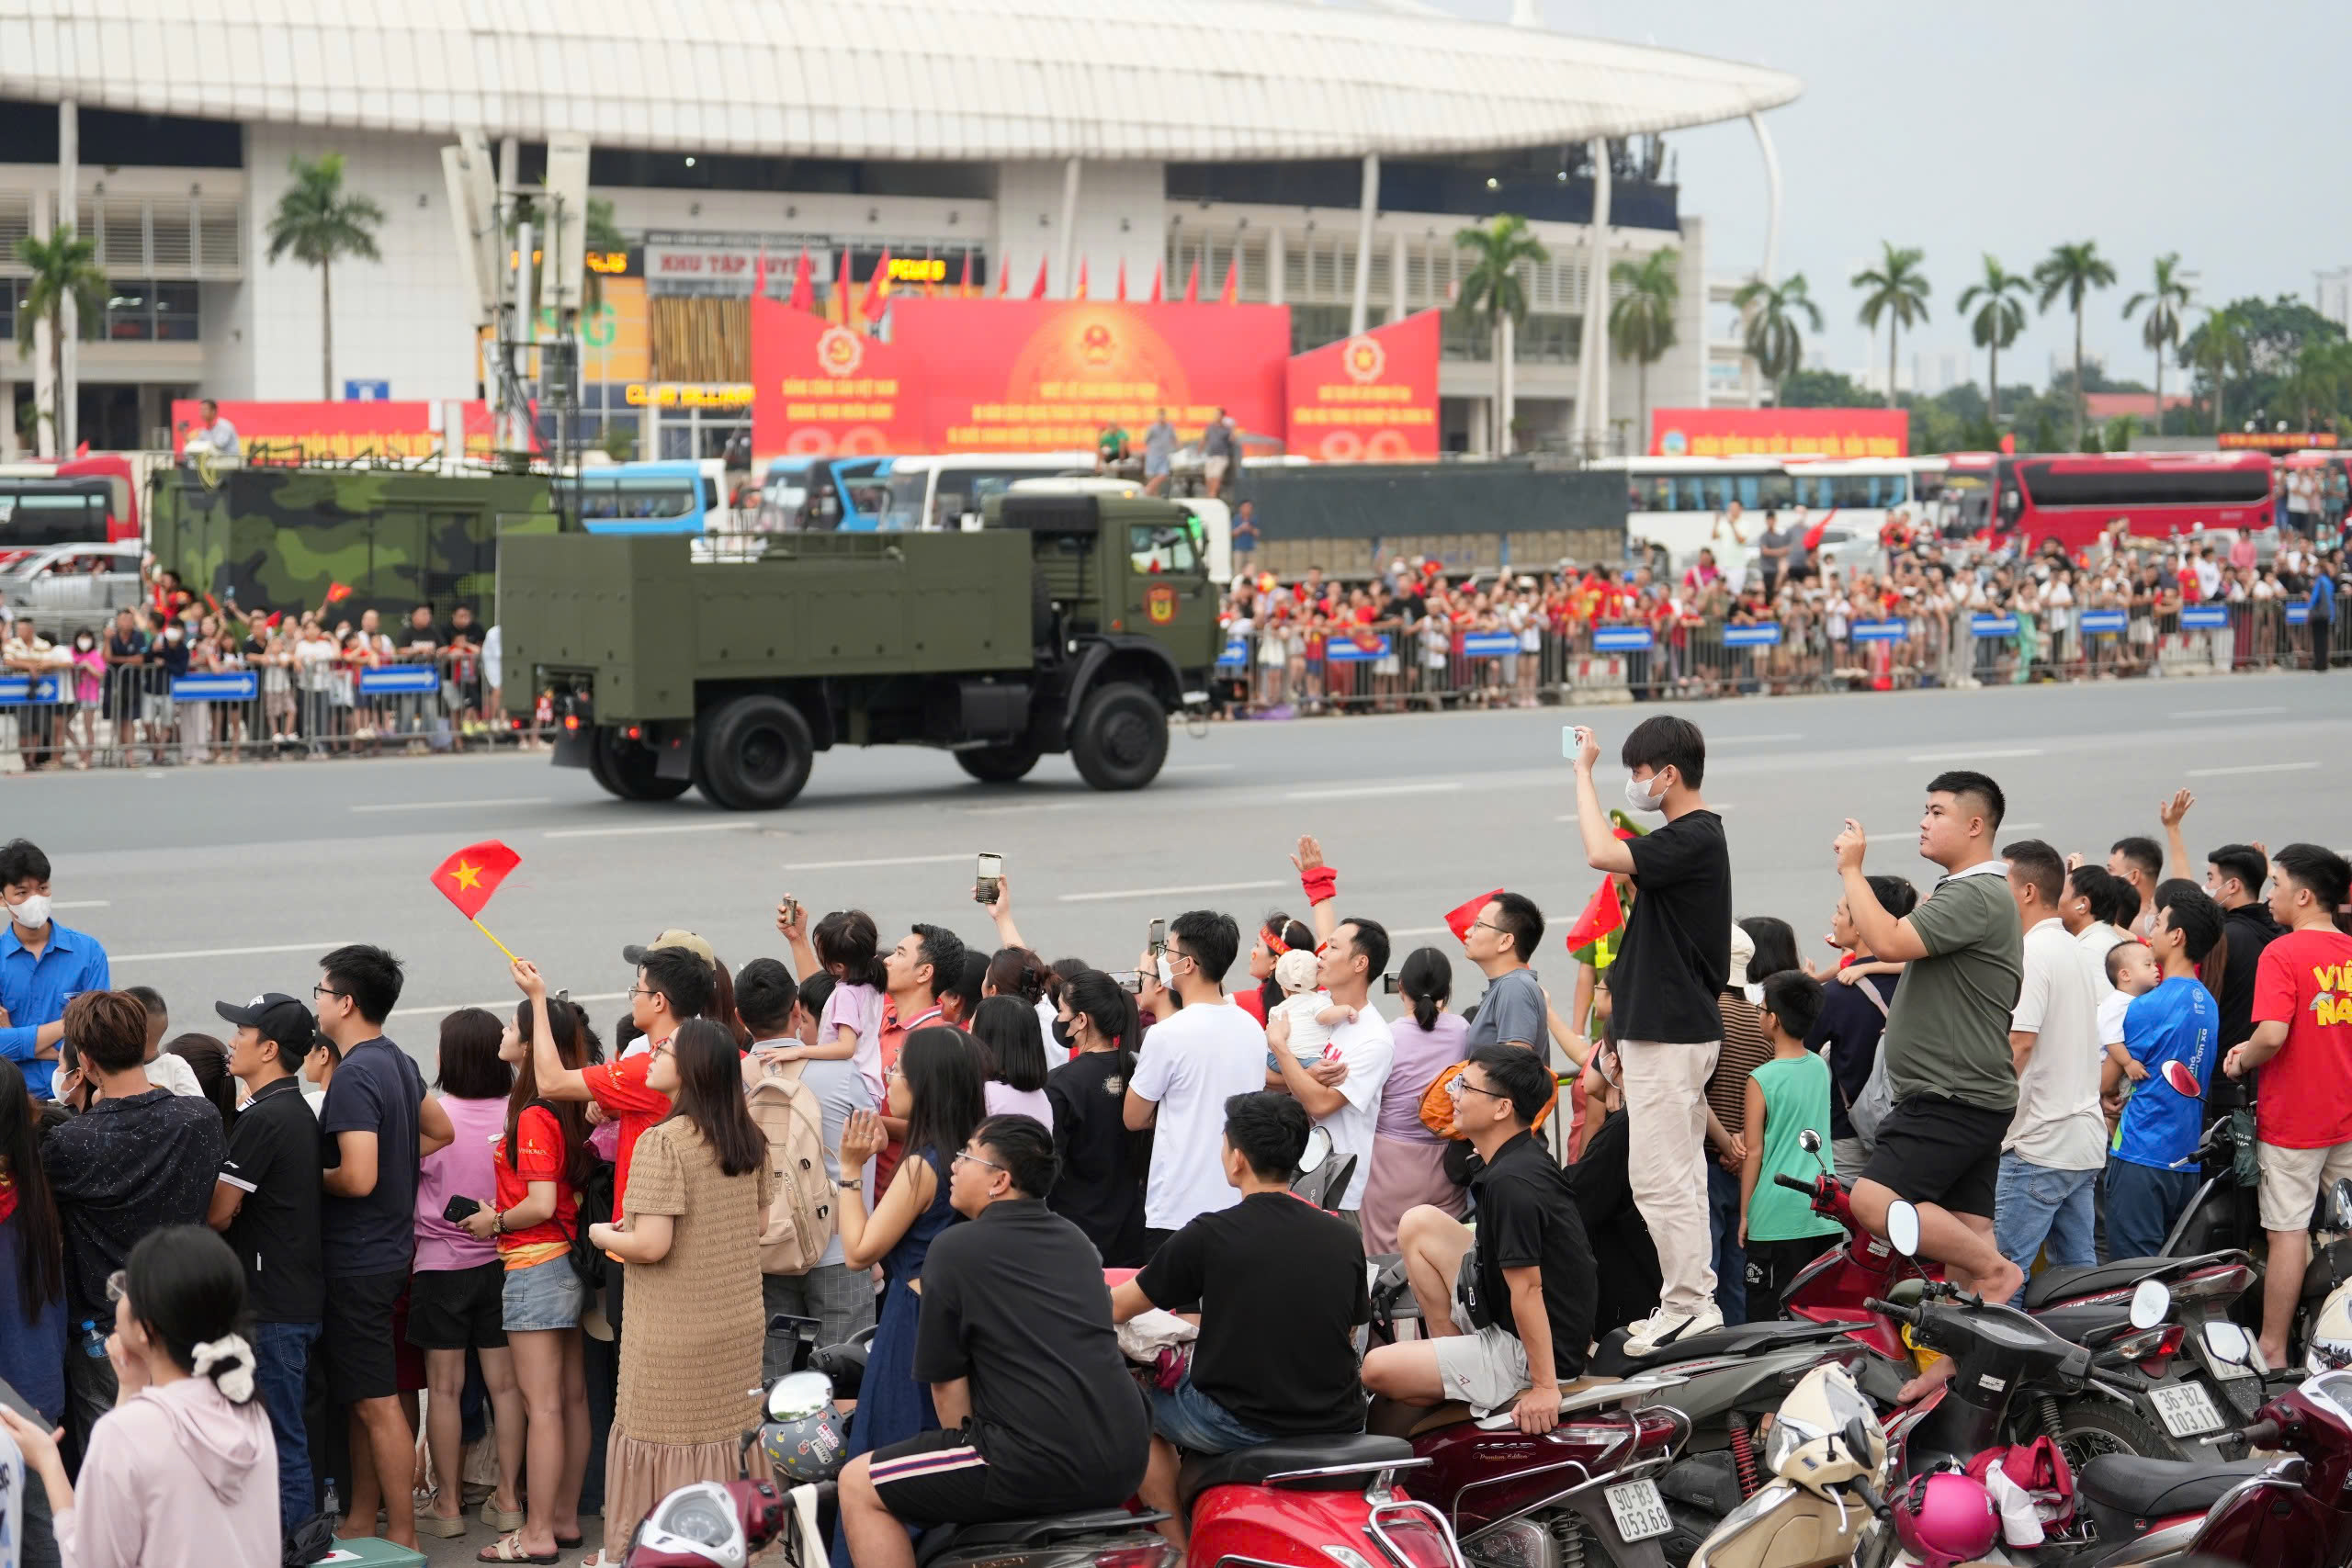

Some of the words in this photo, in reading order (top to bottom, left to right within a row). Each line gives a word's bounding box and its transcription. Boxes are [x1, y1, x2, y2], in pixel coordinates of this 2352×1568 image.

[2158, 1385, 2204, 1412] 36-B2
[2168, 1406, 2220, 1434] 103.11
[1612, 1483, 1654, 1511] 90-B3
[1619, 1506, 1668, 1538] 053.68
